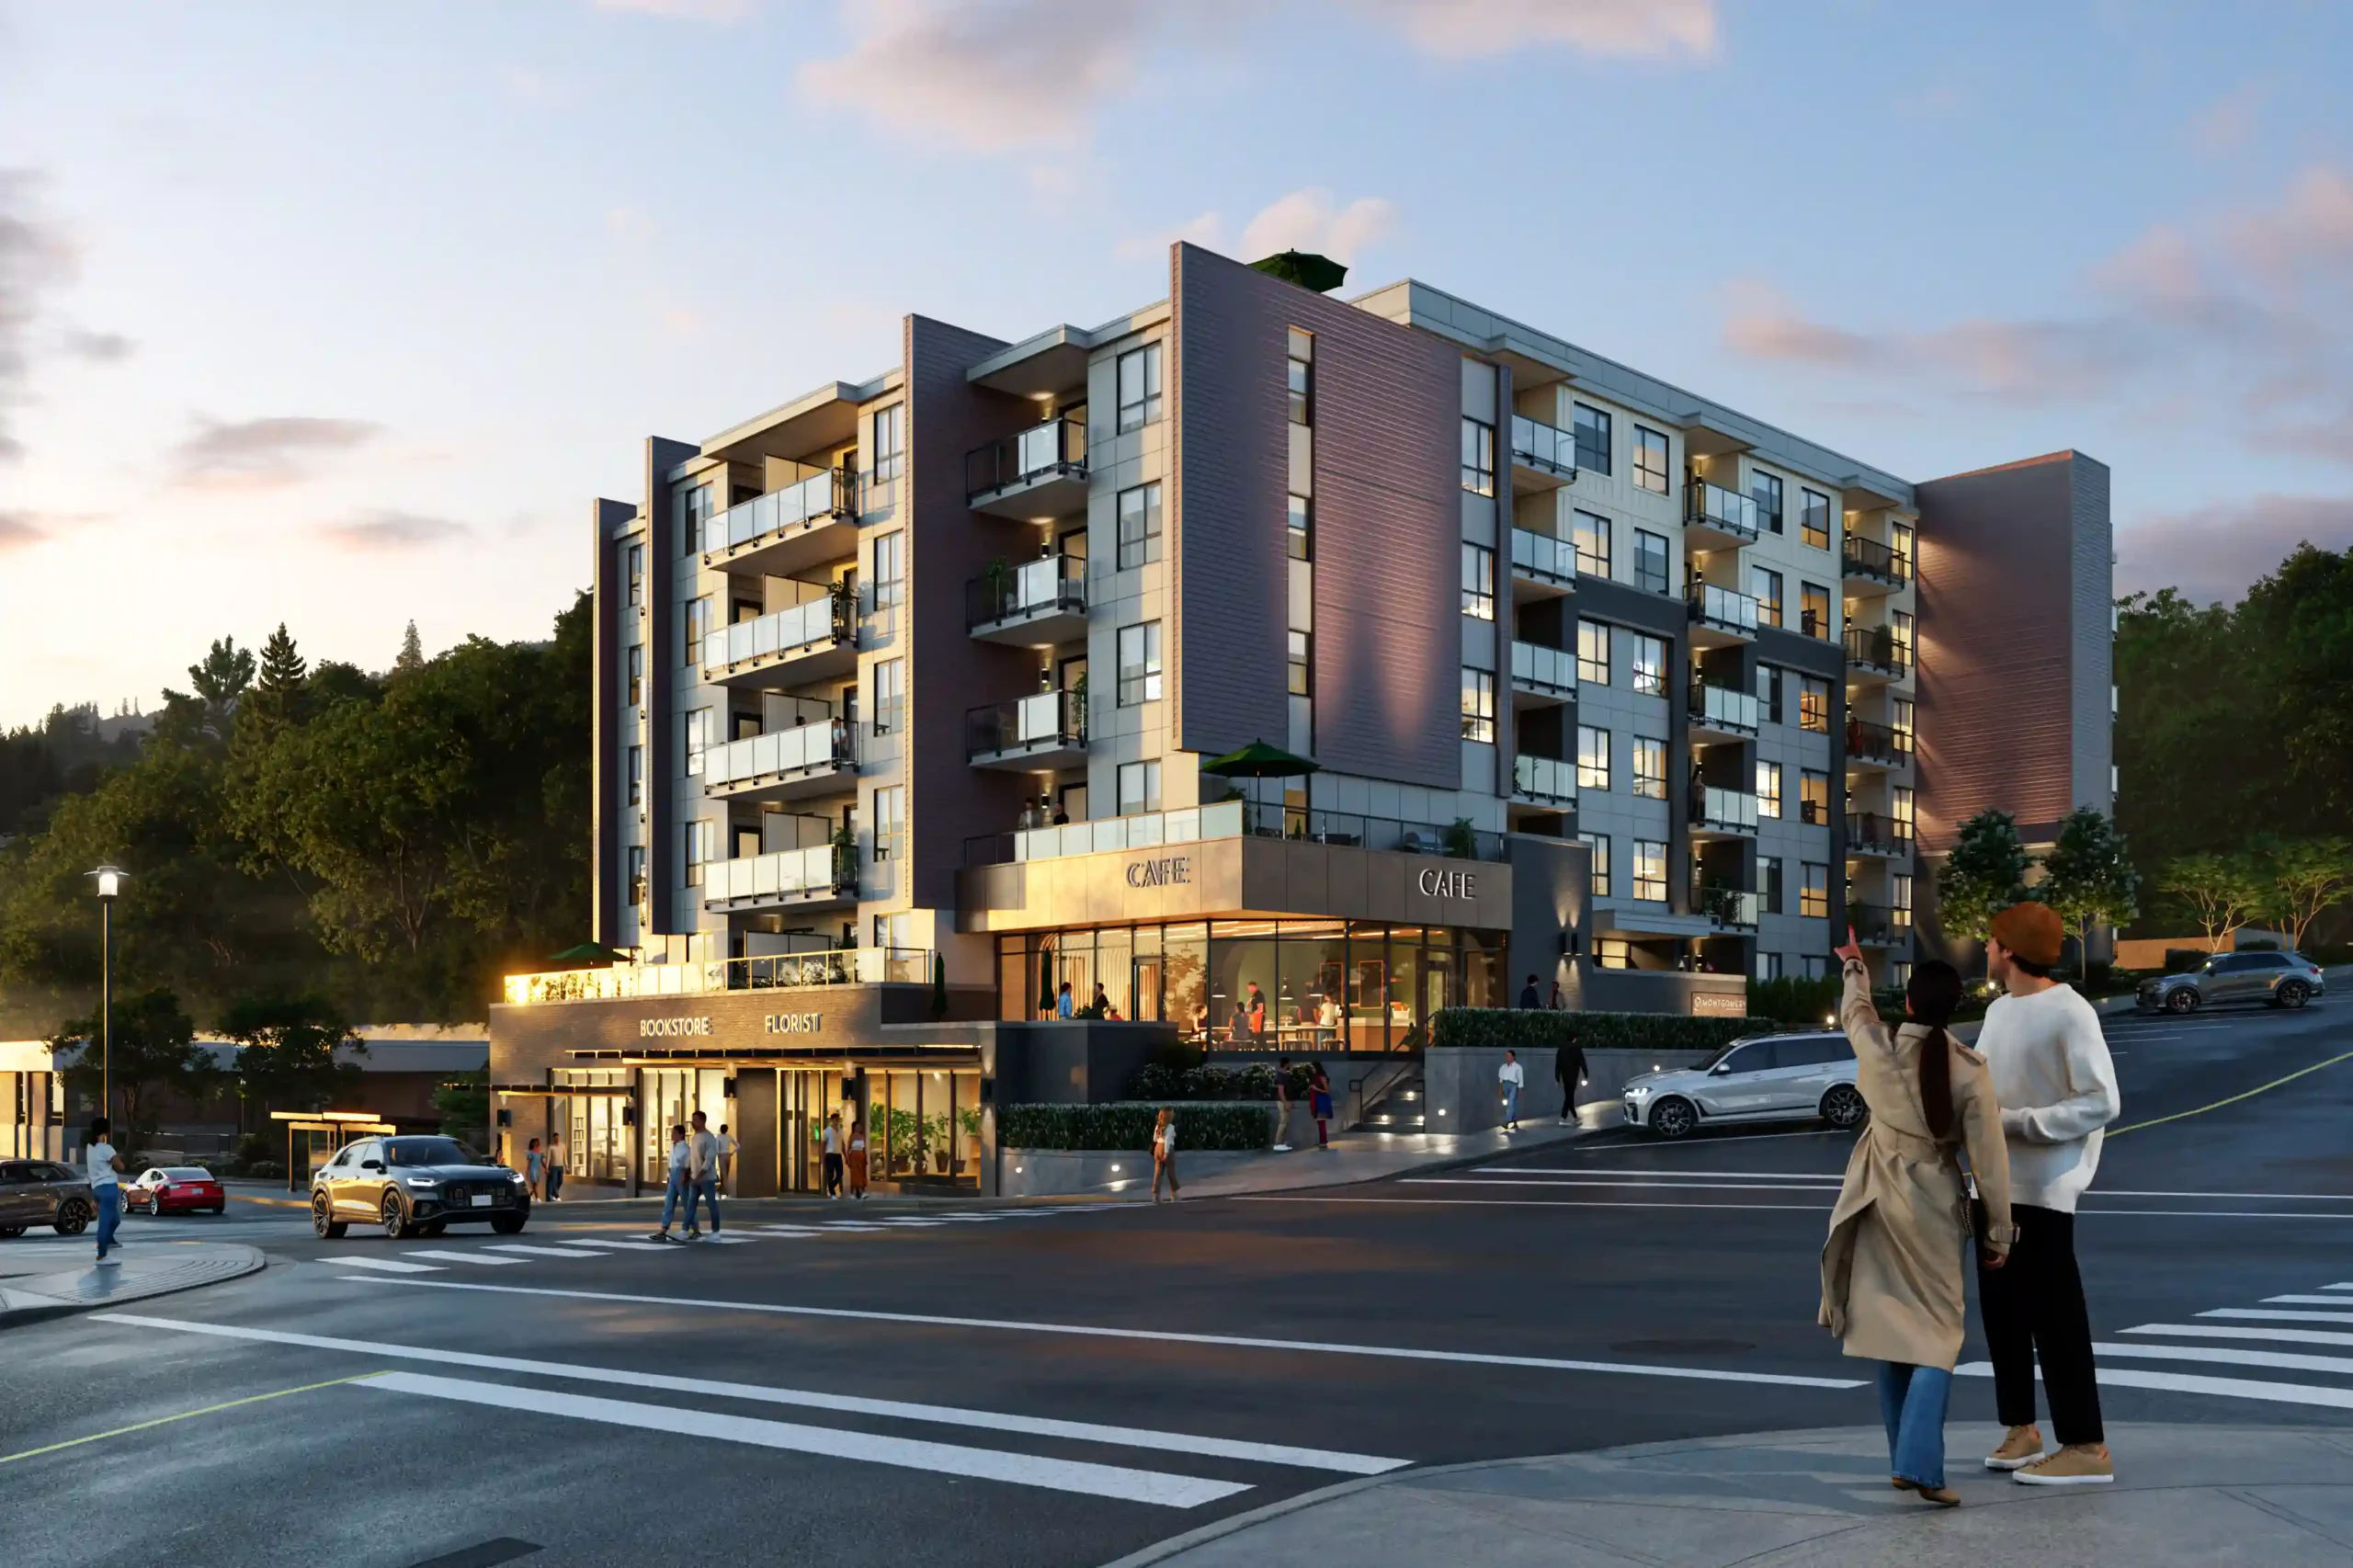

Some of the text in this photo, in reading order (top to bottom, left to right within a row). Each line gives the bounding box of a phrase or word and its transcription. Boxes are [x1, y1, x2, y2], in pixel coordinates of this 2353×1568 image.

[1126, 857, 1190, 888] CAFE
[1419, 868, 1476, 899] CAFE
[640, 1017, 710, 1037] BOOKSTORE
[765, 1013, 821, 1033] FLORIST
